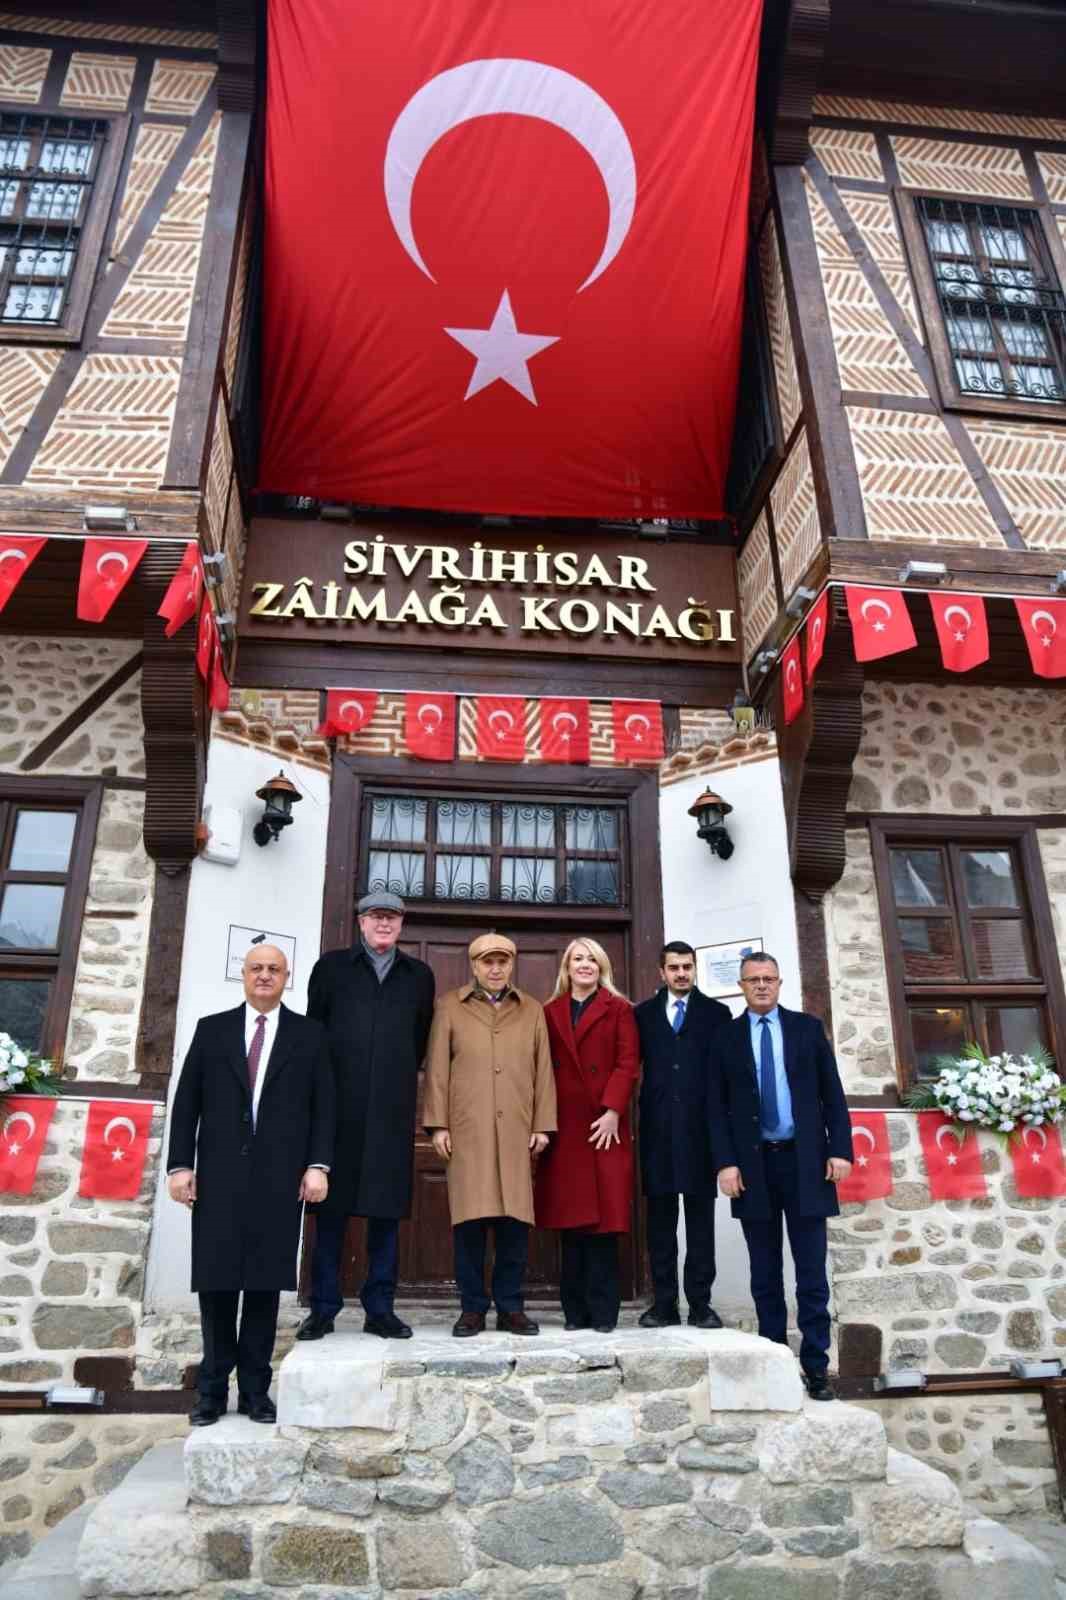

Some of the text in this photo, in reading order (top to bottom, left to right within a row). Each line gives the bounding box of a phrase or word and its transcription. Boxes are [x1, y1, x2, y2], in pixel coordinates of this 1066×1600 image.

[343, 534, 656, 591] SİVRİHİSAR
[248, 576, 737, 642] ZÂİMAĞA KONAĞI
